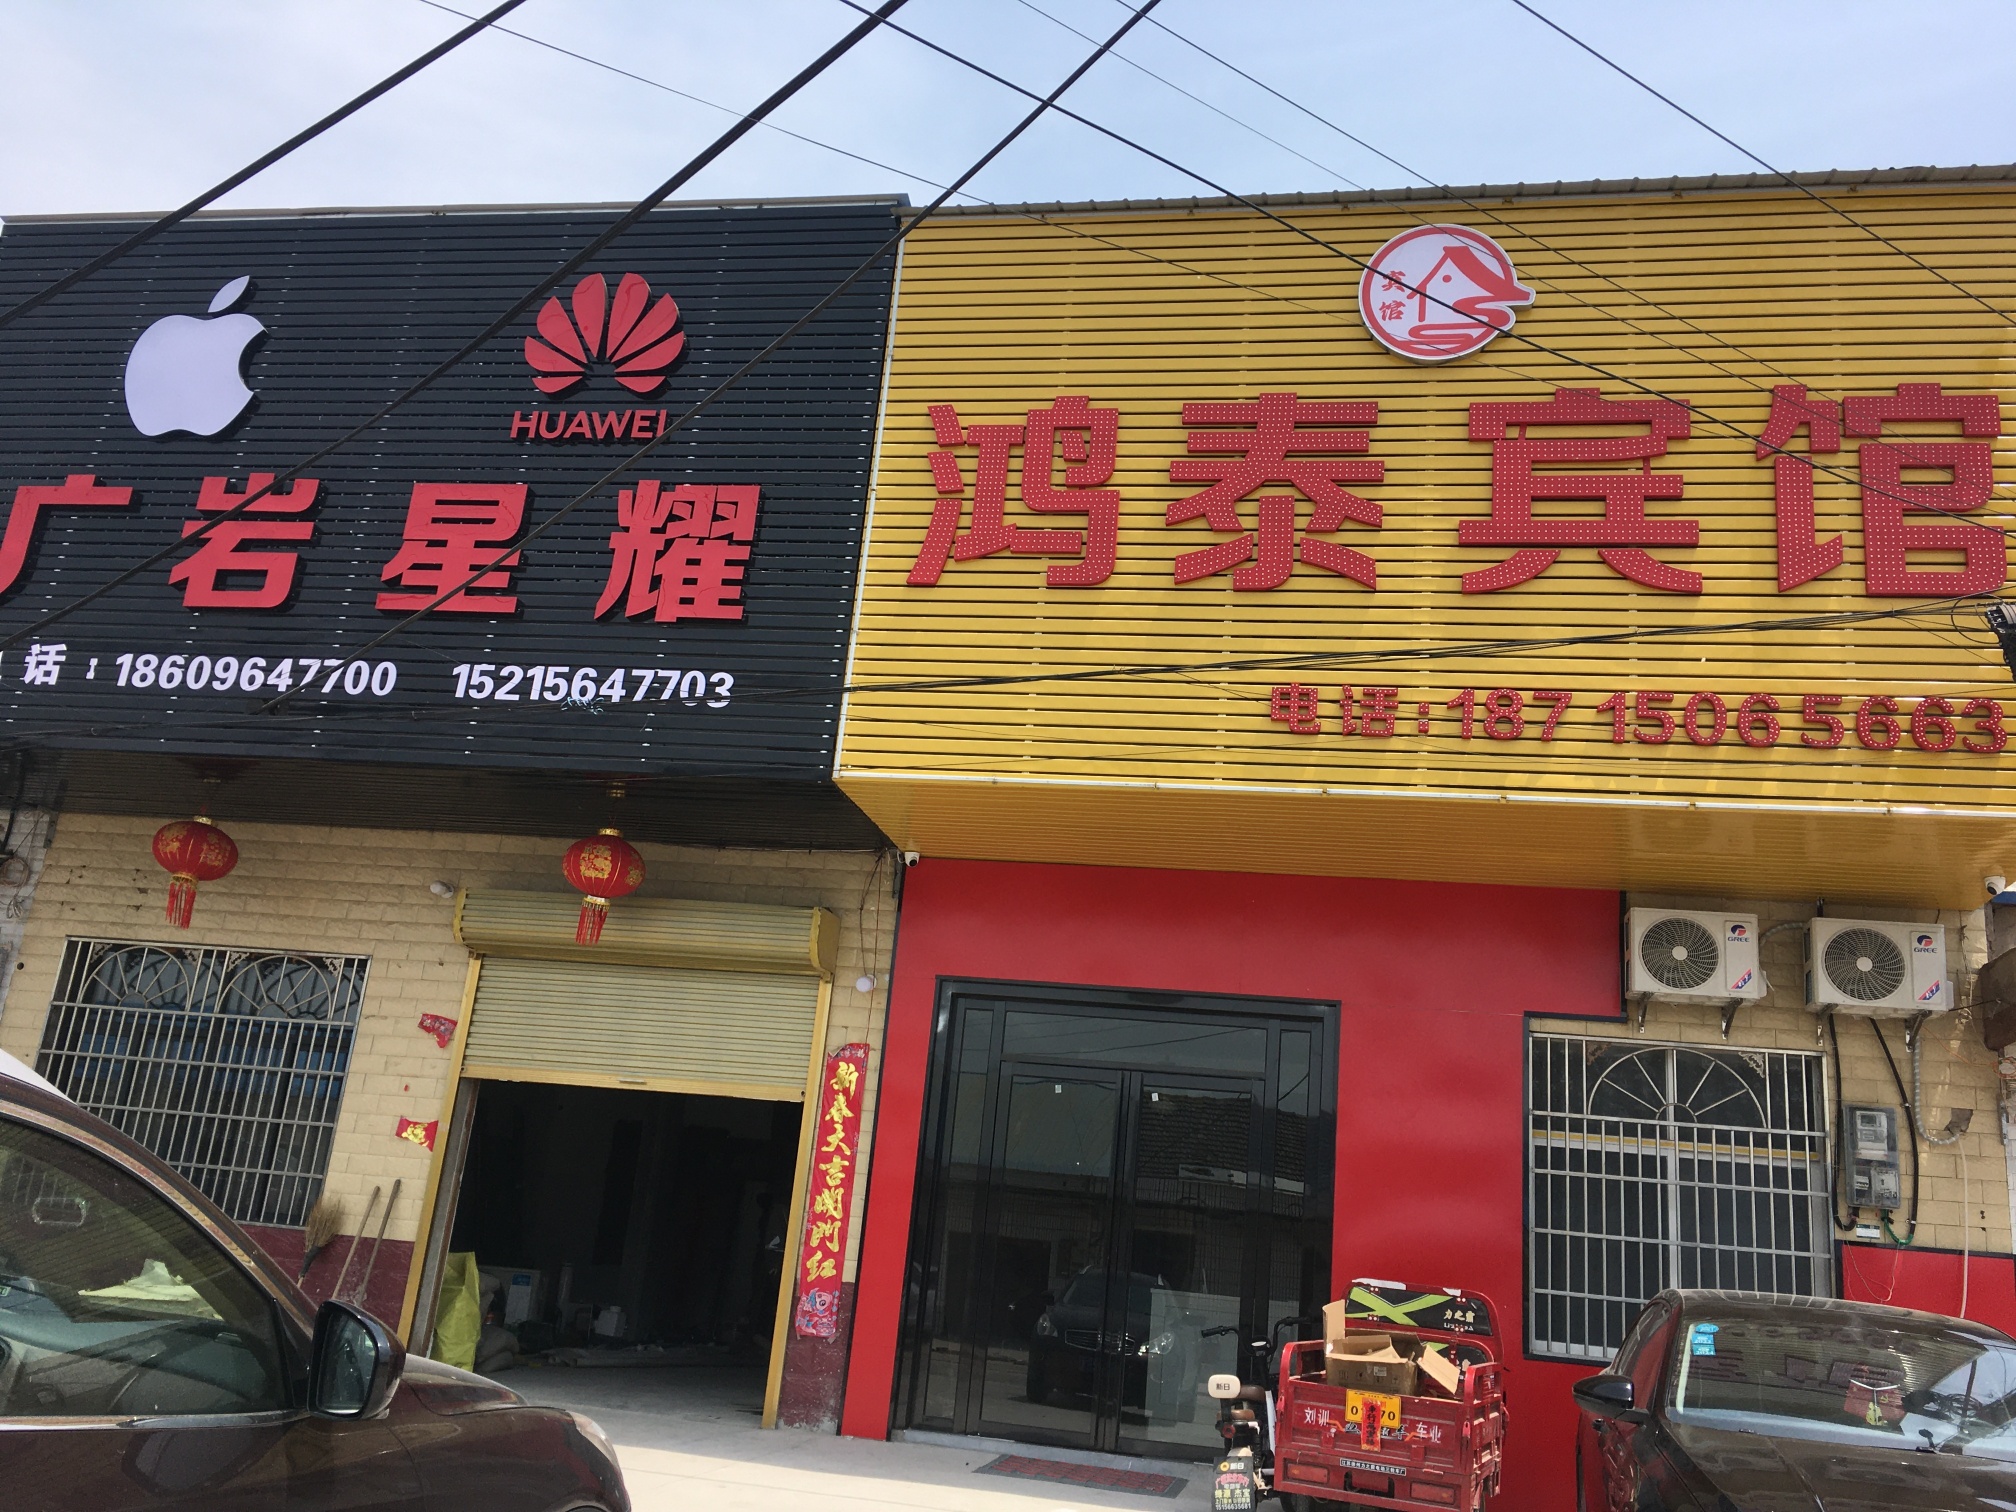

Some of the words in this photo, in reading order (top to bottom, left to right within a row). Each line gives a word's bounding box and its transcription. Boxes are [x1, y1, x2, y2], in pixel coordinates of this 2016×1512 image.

[1378, 270, 1406, 322] 宾馆
[509, 409, 668, 439] HUAWEI
[906, 382, 2007, 597] 鸿泰宾馆
[0, 473, 760, 622] 广岩星耀
[0, 643, 398, 697] 话：18609647700
[451, 663, 734, 708] 15215647703
[1216, 1382, 1231, 1391] 新日
